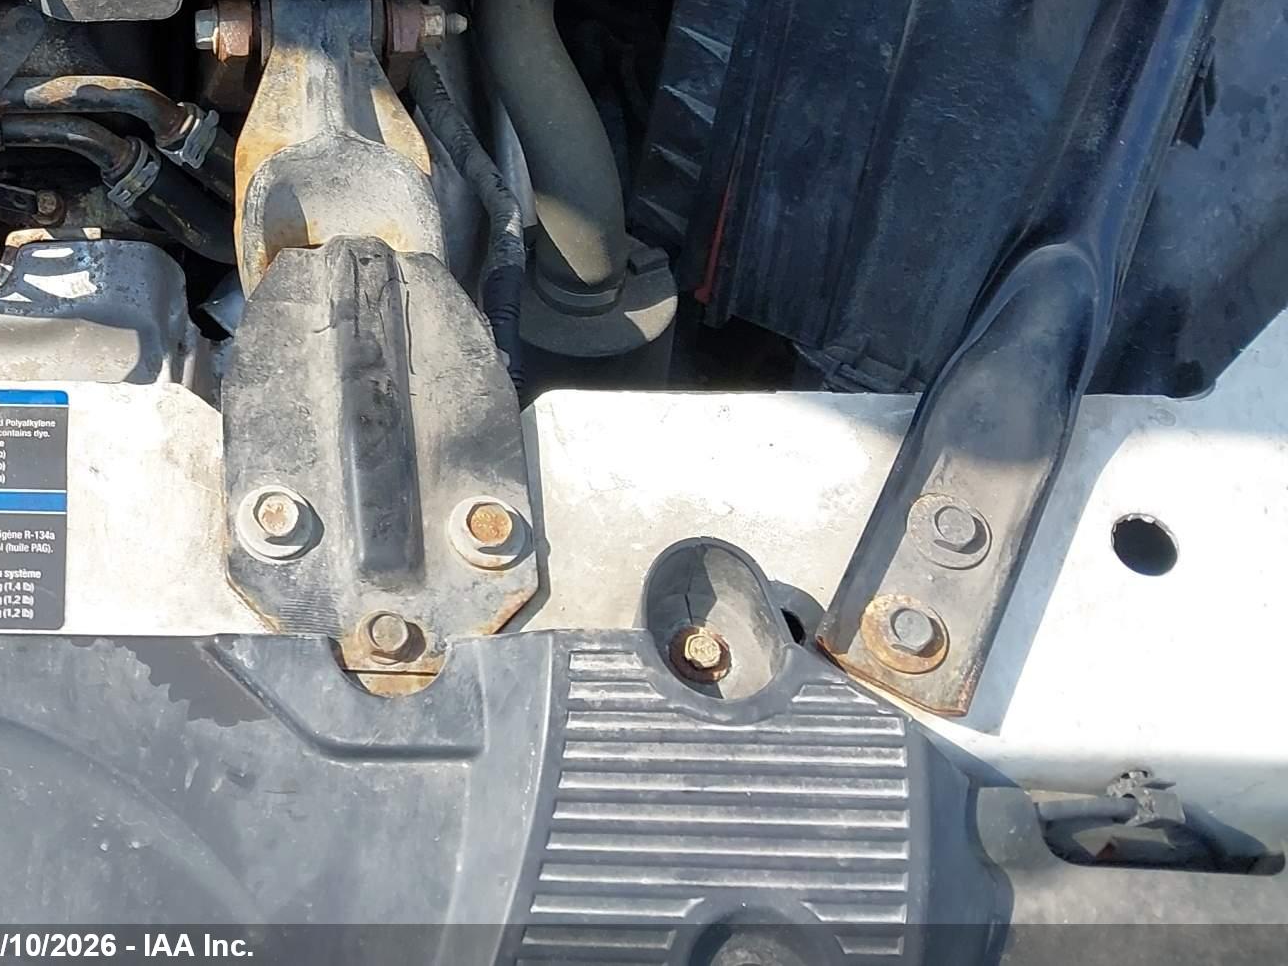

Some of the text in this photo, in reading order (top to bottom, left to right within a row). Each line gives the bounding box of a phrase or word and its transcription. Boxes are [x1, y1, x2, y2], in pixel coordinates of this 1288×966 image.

[34, 430, 50, 439] dye.
[24, 531, 55, 540] R-134a
[5, 543, 30, 553] (huile
[31, 543, 54, 554] PAG).
